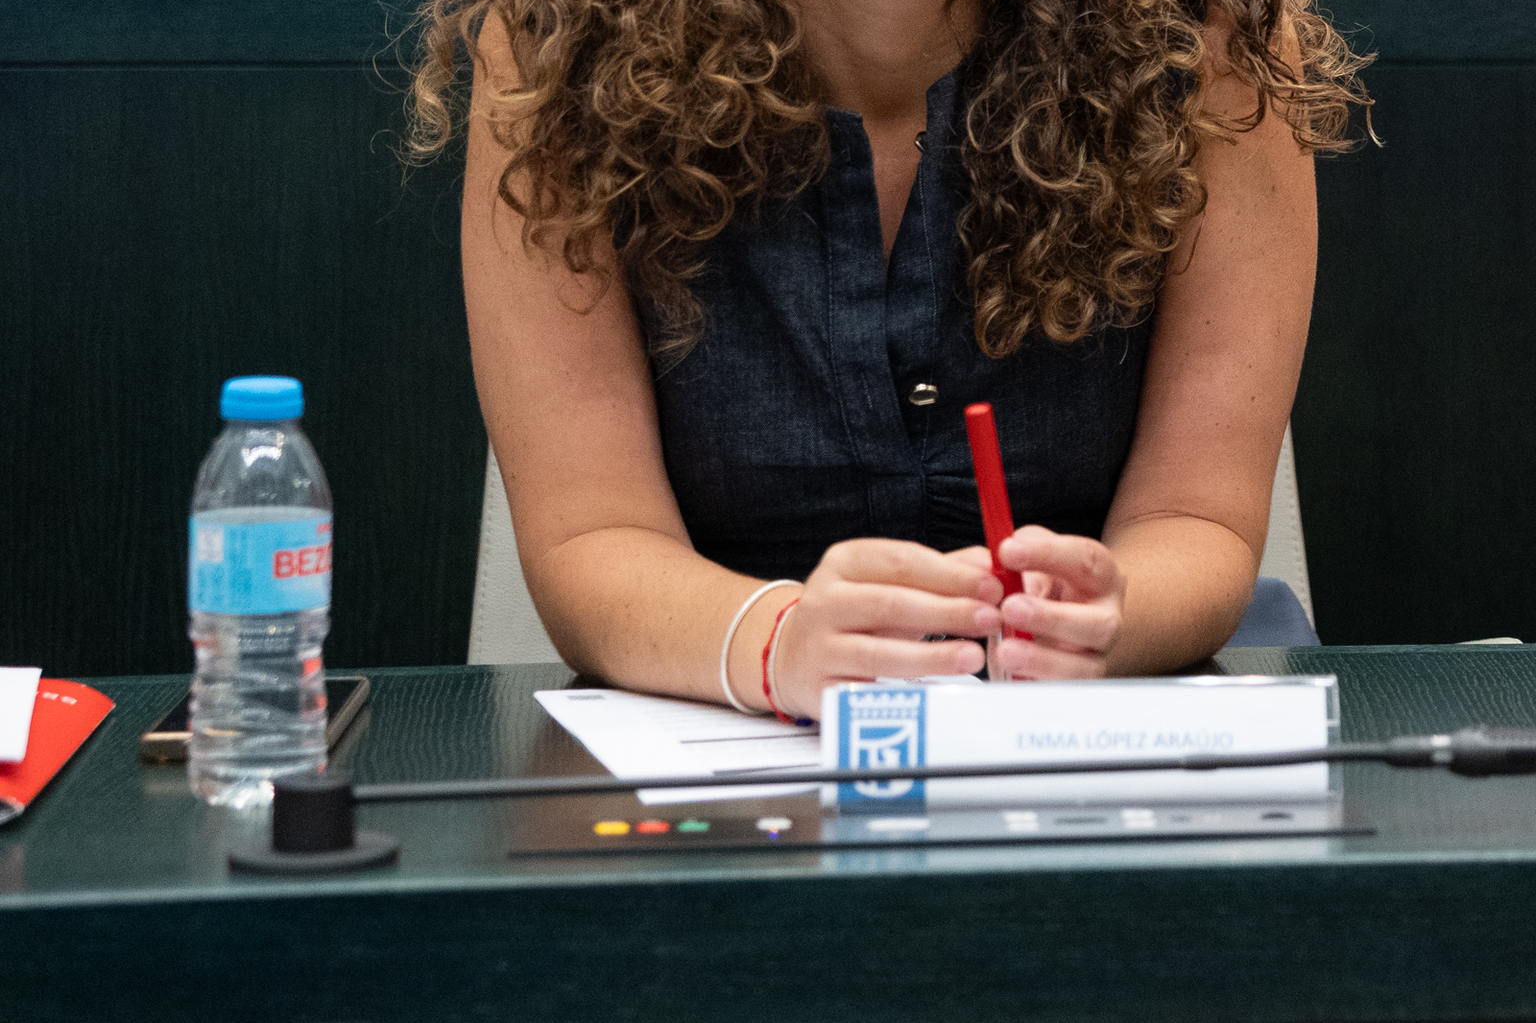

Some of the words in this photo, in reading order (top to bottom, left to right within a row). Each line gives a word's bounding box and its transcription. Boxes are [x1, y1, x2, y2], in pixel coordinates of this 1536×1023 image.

[1015, 731, 1080, 750] ENMA
[1085, 728, 1147, 750] LÓPEZ
[1153, 728, 1235, 750] ARAÚJO
